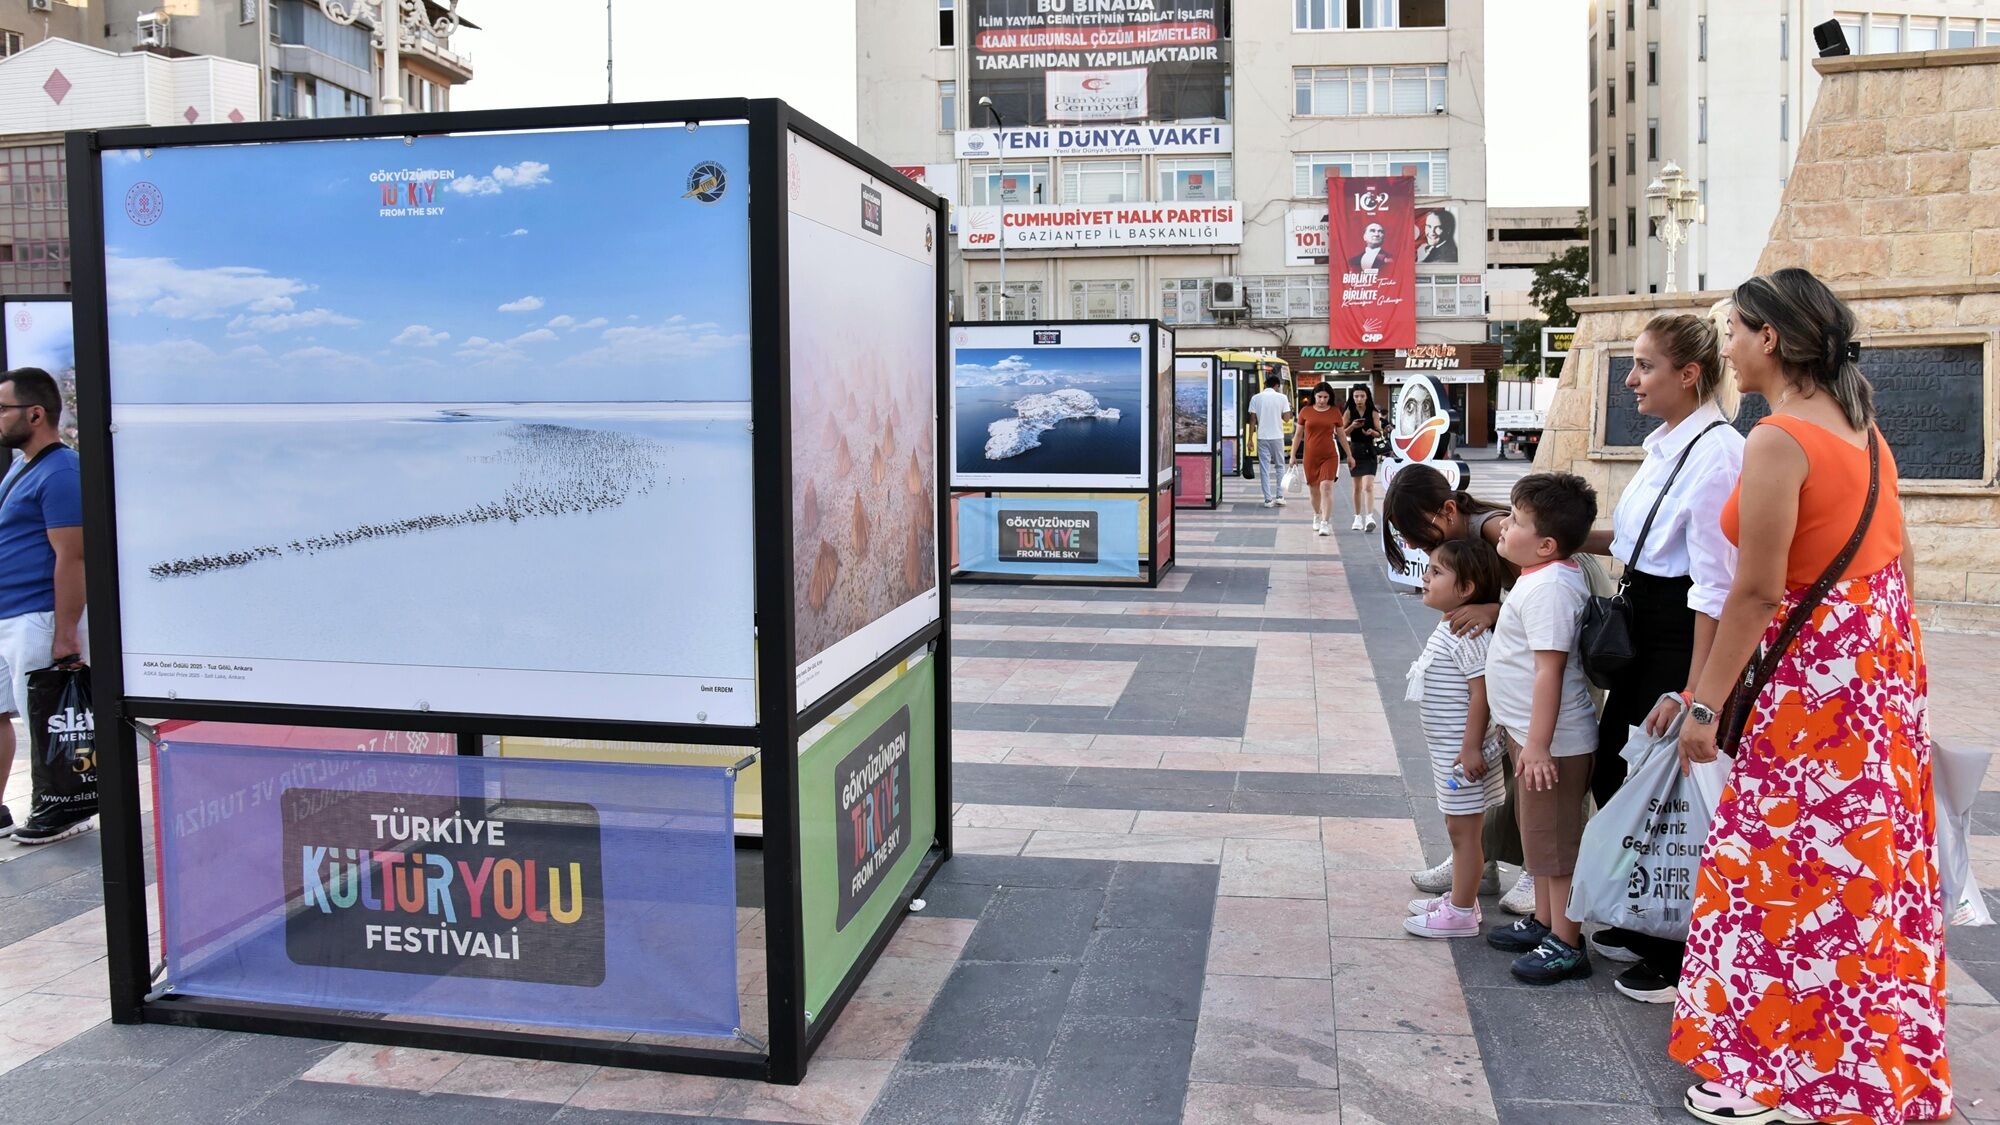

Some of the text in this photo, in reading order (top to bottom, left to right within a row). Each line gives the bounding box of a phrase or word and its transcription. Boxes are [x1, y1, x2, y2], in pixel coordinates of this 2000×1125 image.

[1005, 15, 1044, 26] YAYMA
[1127, 9, 1174, 23] TADİLAT
[1177, 7, 1214, 20] İŞLERİ
[982, 24, 1211, 48] KAAN KURUMSAL ÇÖZÜM HİZMETLERİ
[976, 46, 1218, 70] TARAFINDAN YAPILMAKTADIR
[1054, 102, 1138, 114] Cemiyeti
[993, 127, 1220, 150] YENİ DÜNYA VAKFI
[369, 168, 455, 182] GÖKYÜZÜNDEN
[380, 207, 445, 217] FROM THE SKY
[1003, 205, 1233, 227] CUMHURİYET HALK PARTİSİ
[969, 233, 995, 244] CHP
[1018, 225, 1219, 242] GAZİANTEP İL BAŞKANLIĞI
[1295, 233, 1326, 247] 101.
[1342, 270, 1378, 284] BİRLİKTE
[1342, 287, 1378, 300] BİRLİKTE
[1361, 333, 1384, 342] CHP
[1405, 357, 1460, 370] İLETİŞİM
[1006, 516, 1090, 528] GÖKYÜZÜNDEN
[1016, 527, 1080, 550] TÜRKİYE
[1017, 550, 1080, 559] FROM THE SKY
[700, 685, 713, 693] Ümit
[842, 731, 906, 811] GÖKYÜZÜNDEN
[851, 765, 900, 868] TÜRKİYE
[371, 807, 505, 847] TÜRKİYE
[851, 824, 901, 898] FROM THE SKY
[1653, 867, 1690, 883] SIFIR
[1652, 883, 1690, 900] ATIK
[365, 922, 521, 961] FESTİVALİ
